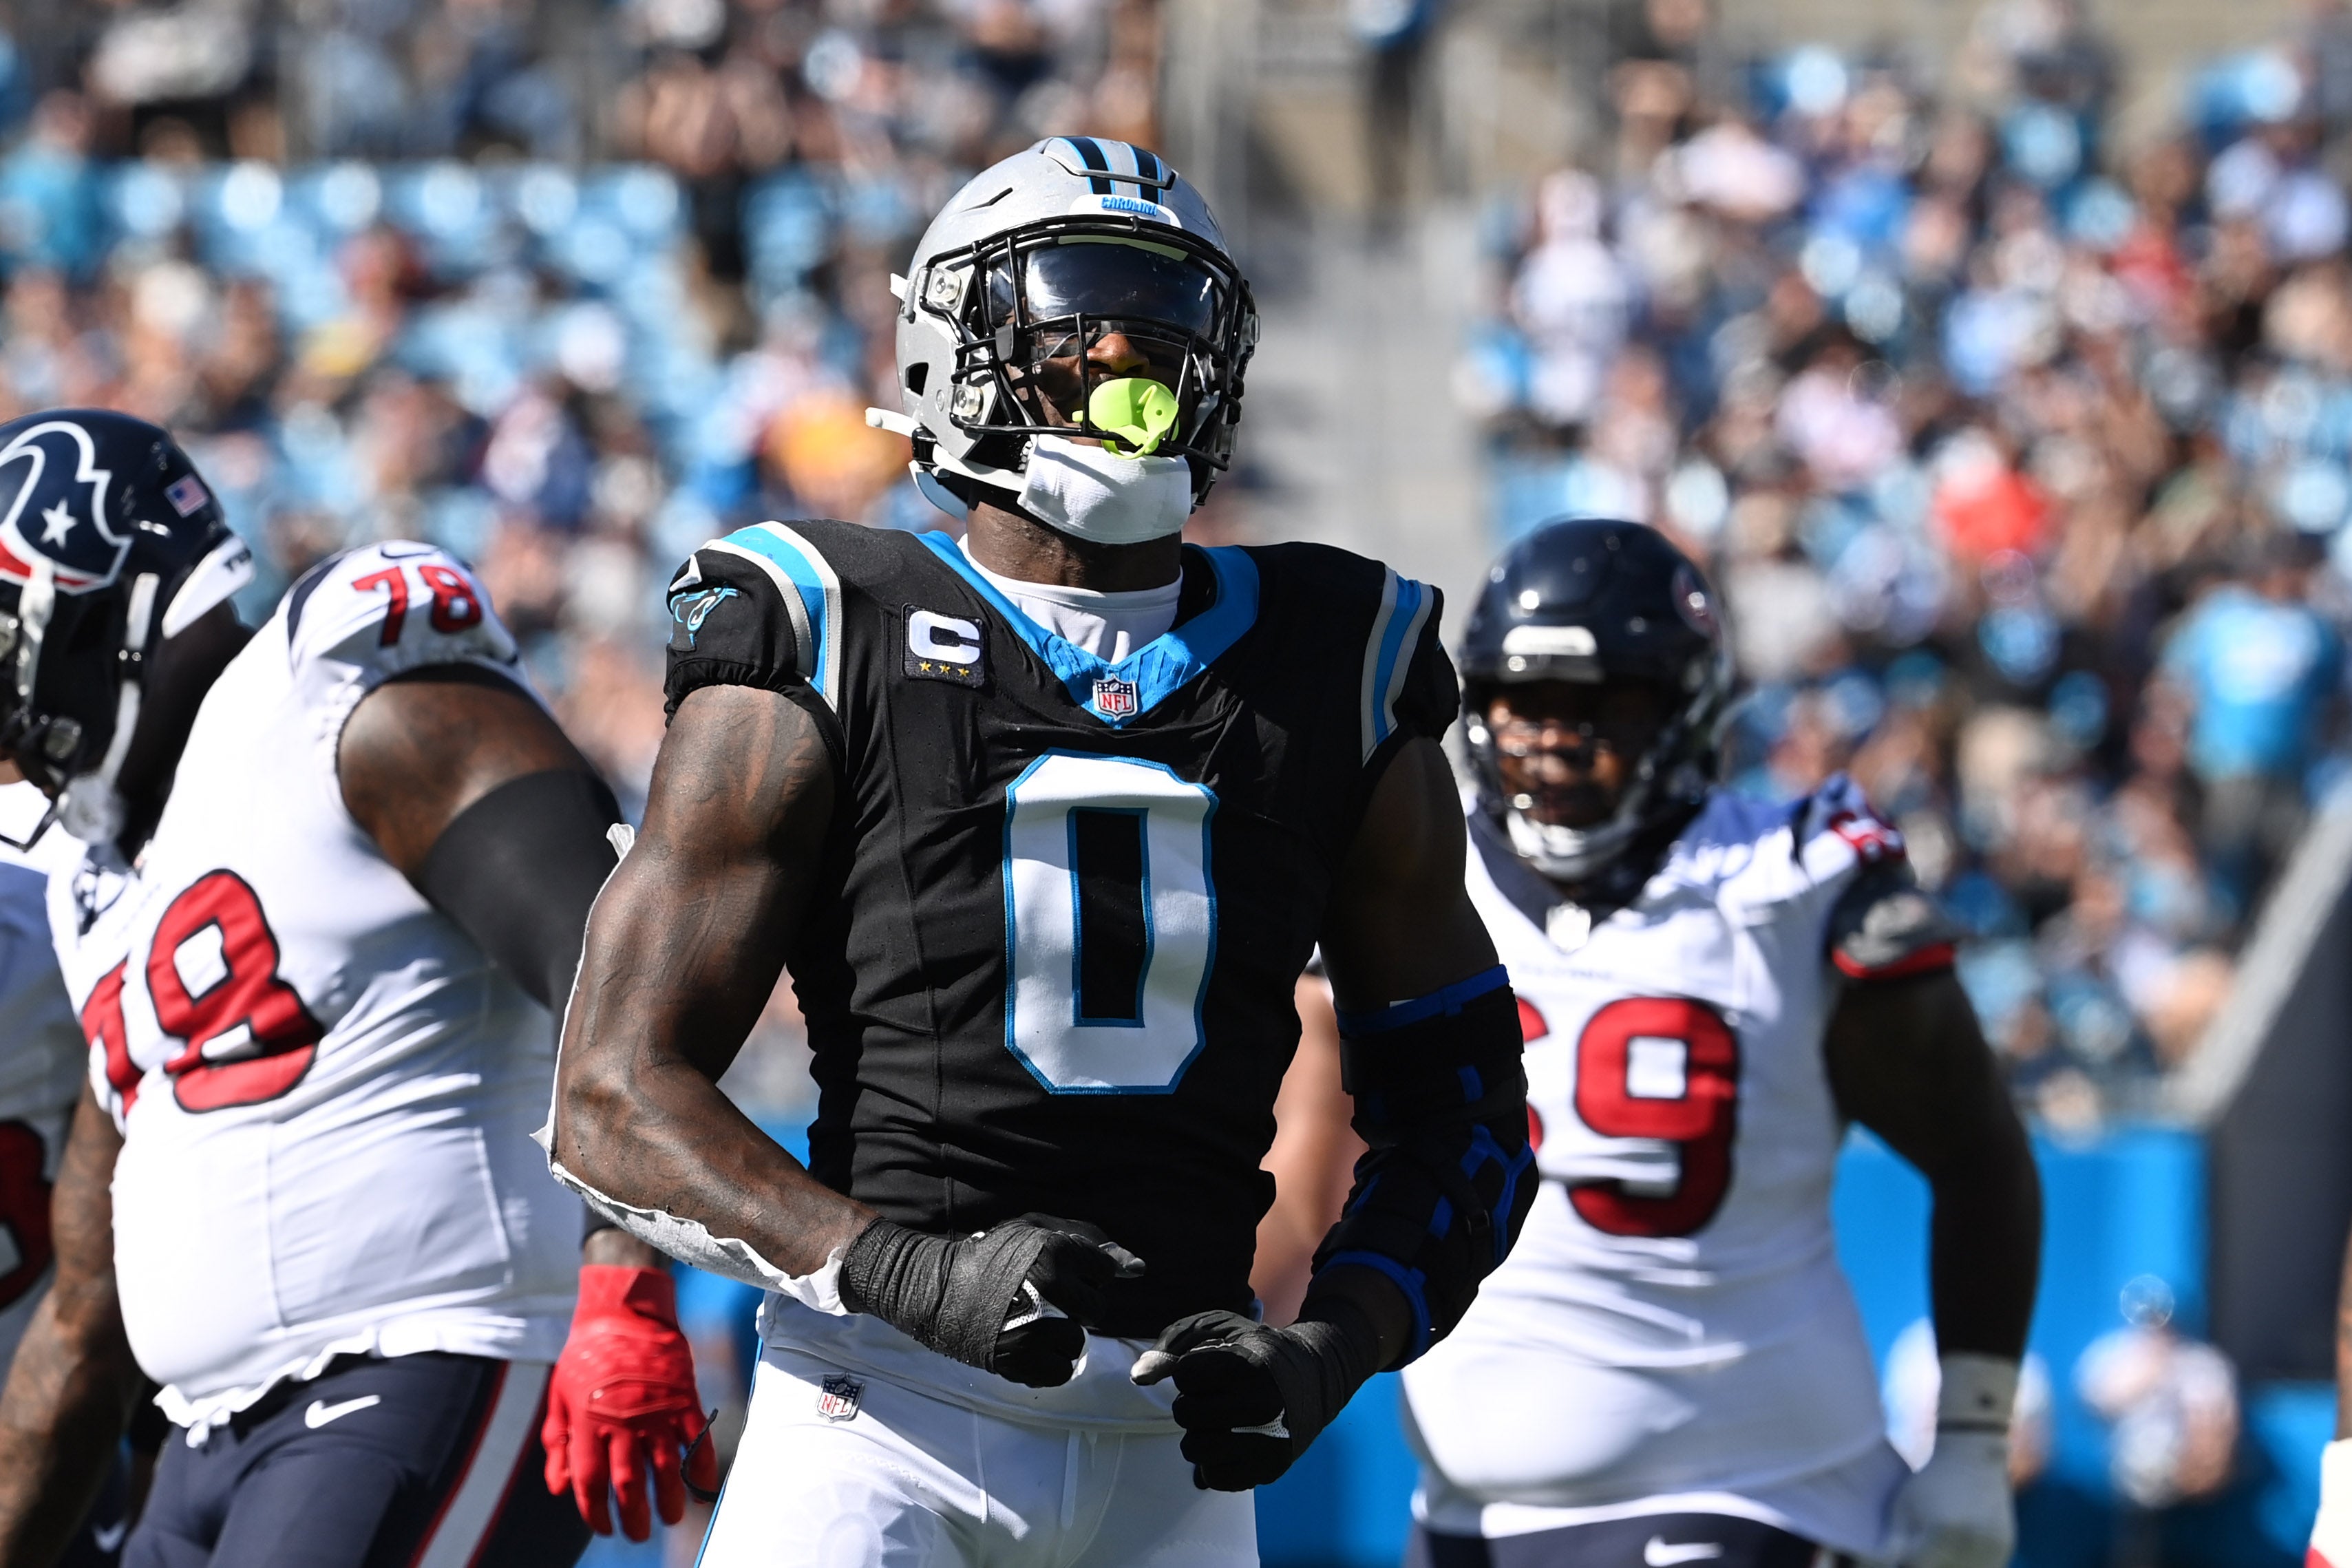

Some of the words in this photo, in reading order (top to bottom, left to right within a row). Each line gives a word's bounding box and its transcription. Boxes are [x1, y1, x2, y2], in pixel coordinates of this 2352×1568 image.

[1101, 196, 1157, 217] CAROLINA
[351, 565, 483, 646] 78
[909, 610, 980, 665] C
[1101, 694, 1131, 711] NFL
[1002, 747, 1219, 1094] 0
[1514, 994, 1739, 1238] 9
[821, 1395, 849, 1414] NFL
